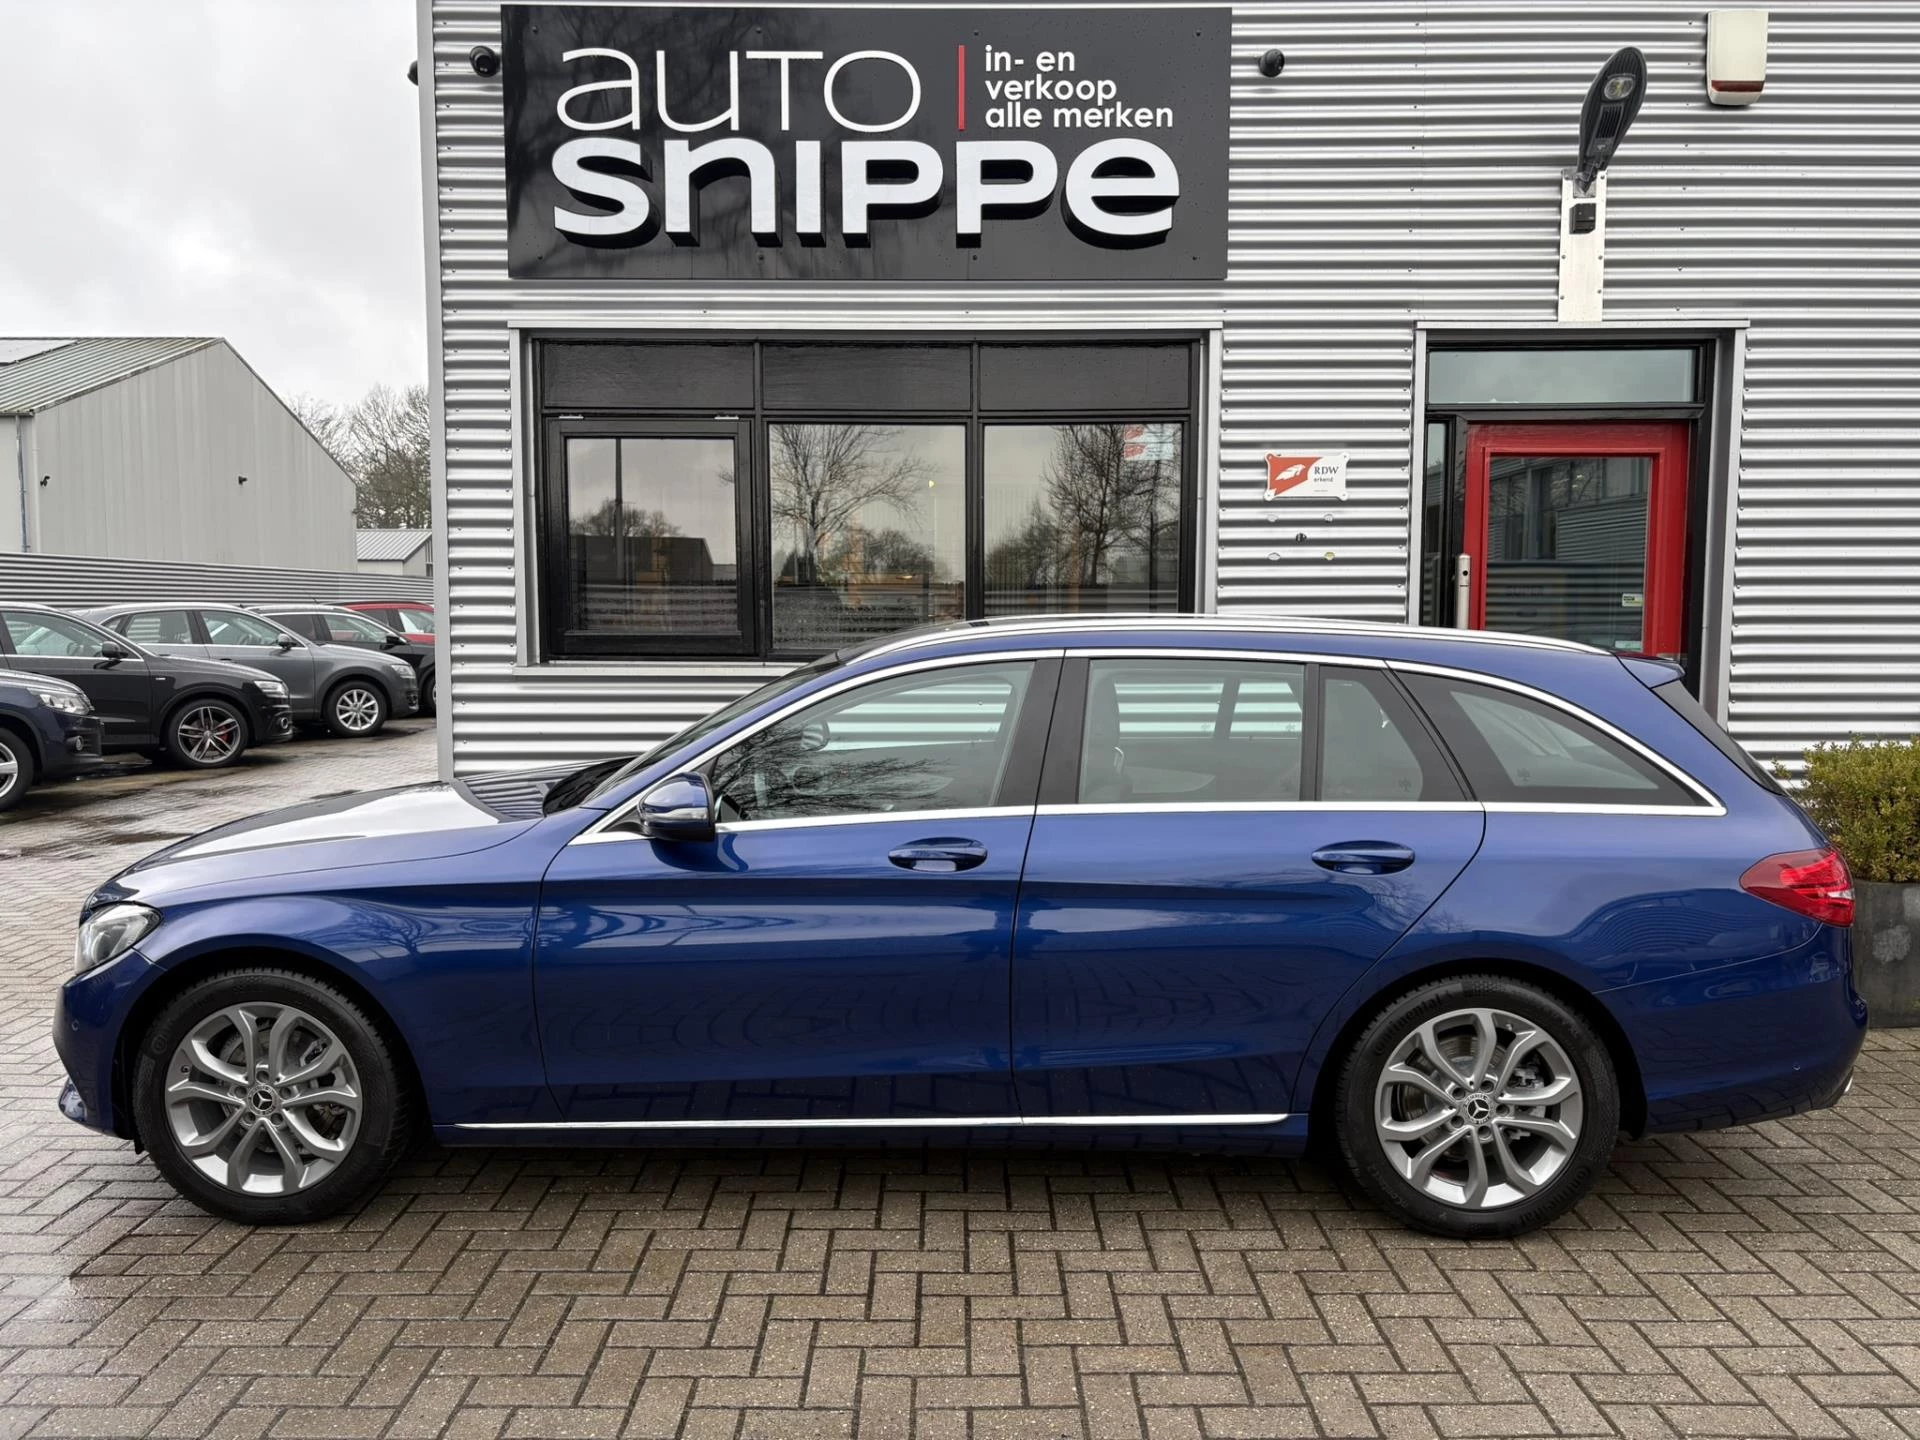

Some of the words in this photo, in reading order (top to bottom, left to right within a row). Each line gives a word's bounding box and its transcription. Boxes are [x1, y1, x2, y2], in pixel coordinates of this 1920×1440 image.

[984, 44, 1025, 72] in-
[1035, 51, 1075, 72] en
[984, 74, 1117, 107] verkoop
[984, 101, 1043, 128] alle
[1053, 101, 1174, 128] merken
[1314, 466, 1340, 474] RDW
